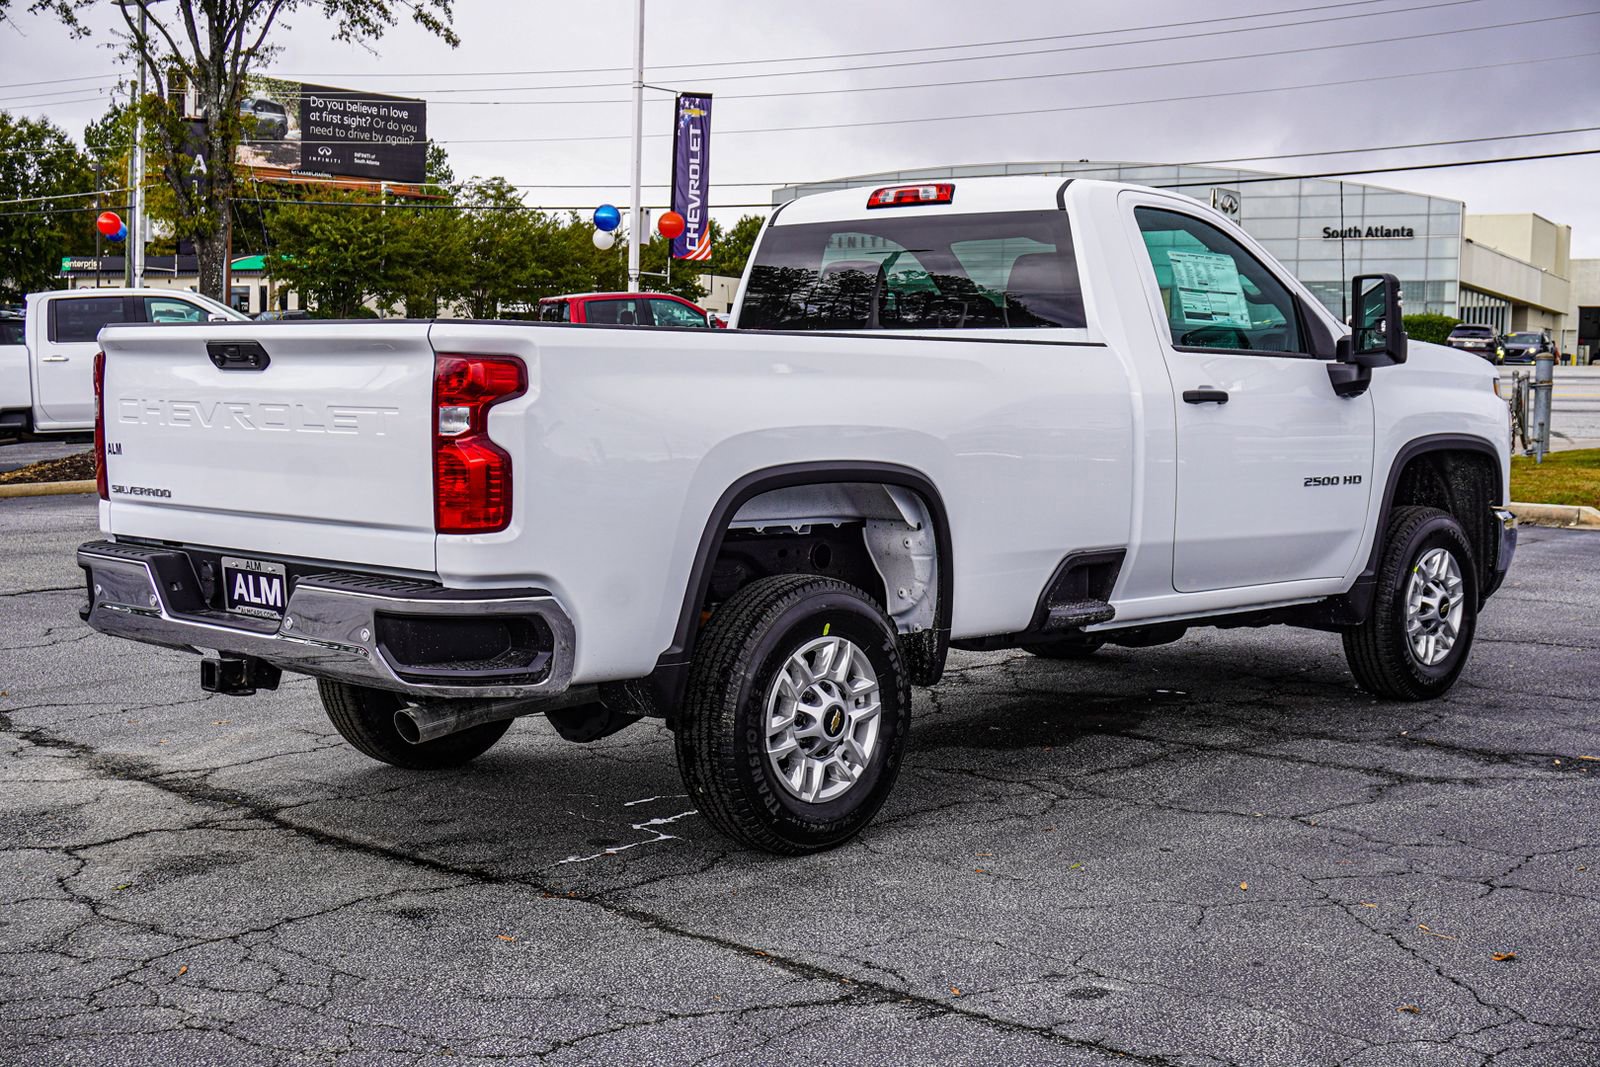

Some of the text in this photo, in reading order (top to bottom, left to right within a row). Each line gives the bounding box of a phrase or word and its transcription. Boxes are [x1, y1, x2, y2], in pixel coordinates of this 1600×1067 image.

[310, 95, 409, 119] Do you believe in love
[309, 111, 418, 134] at first sight? Or do you
[309, 126, 415, 146] need to drive by again?
[309, 156, 341, 164] INFINITI
[686, 124, 702, 251] CHEVROLET
[1322, 225, 1414, 239] South Atlanta
[119, 398, 399, 436] CHEVROLET
[107, 442, 123, 455] ALM
[1303, 475, 1362, 487] 2500 HD
[111, 484, 172, 499] SILVERADO
[245, 560, 262, 571] ALM
[233, 572, 282, 608] ALM
